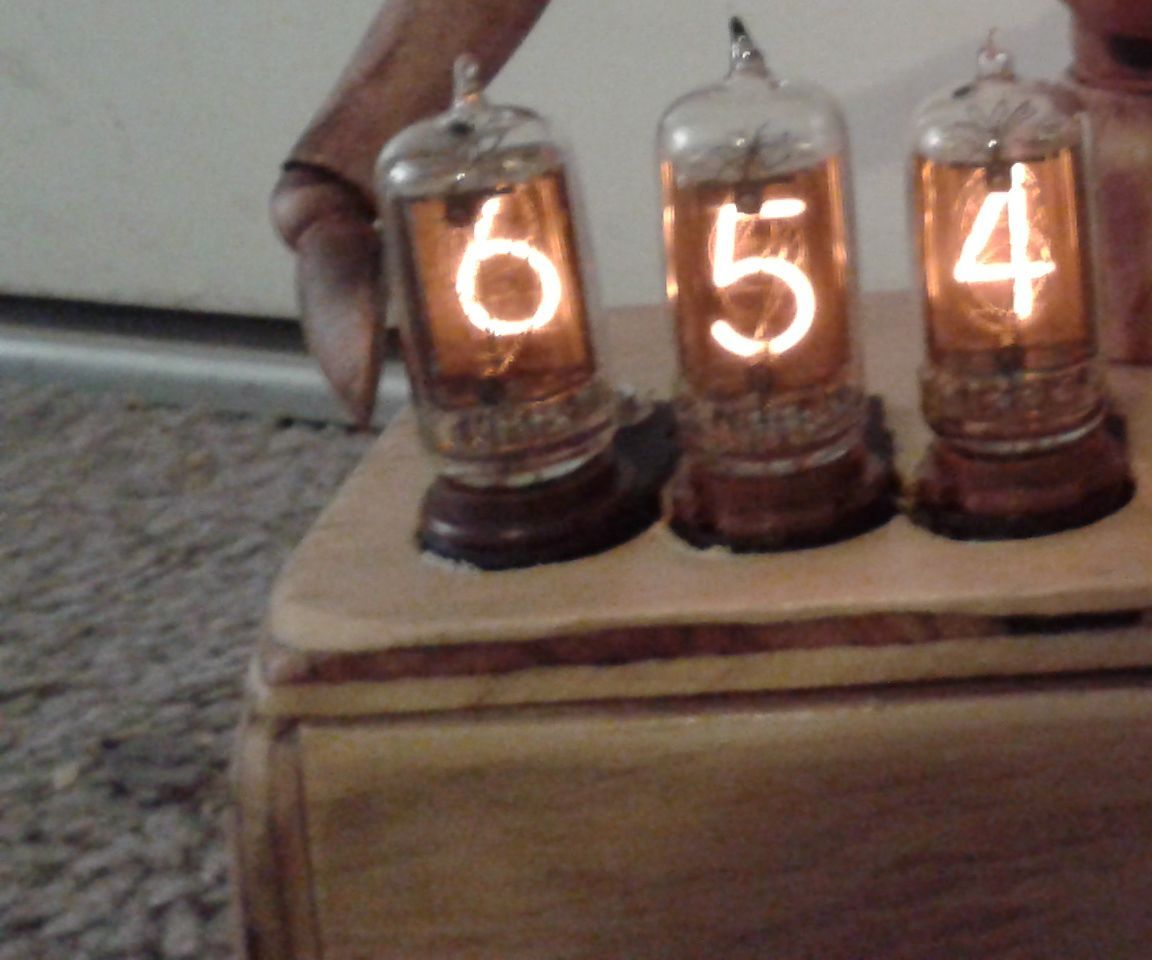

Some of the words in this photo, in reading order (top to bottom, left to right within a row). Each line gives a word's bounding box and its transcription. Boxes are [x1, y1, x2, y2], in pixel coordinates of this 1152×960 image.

[453, 195, 564, 338] 6
[709, 196, 817, 358] 5
[952, 161, 1057, 322] 4
